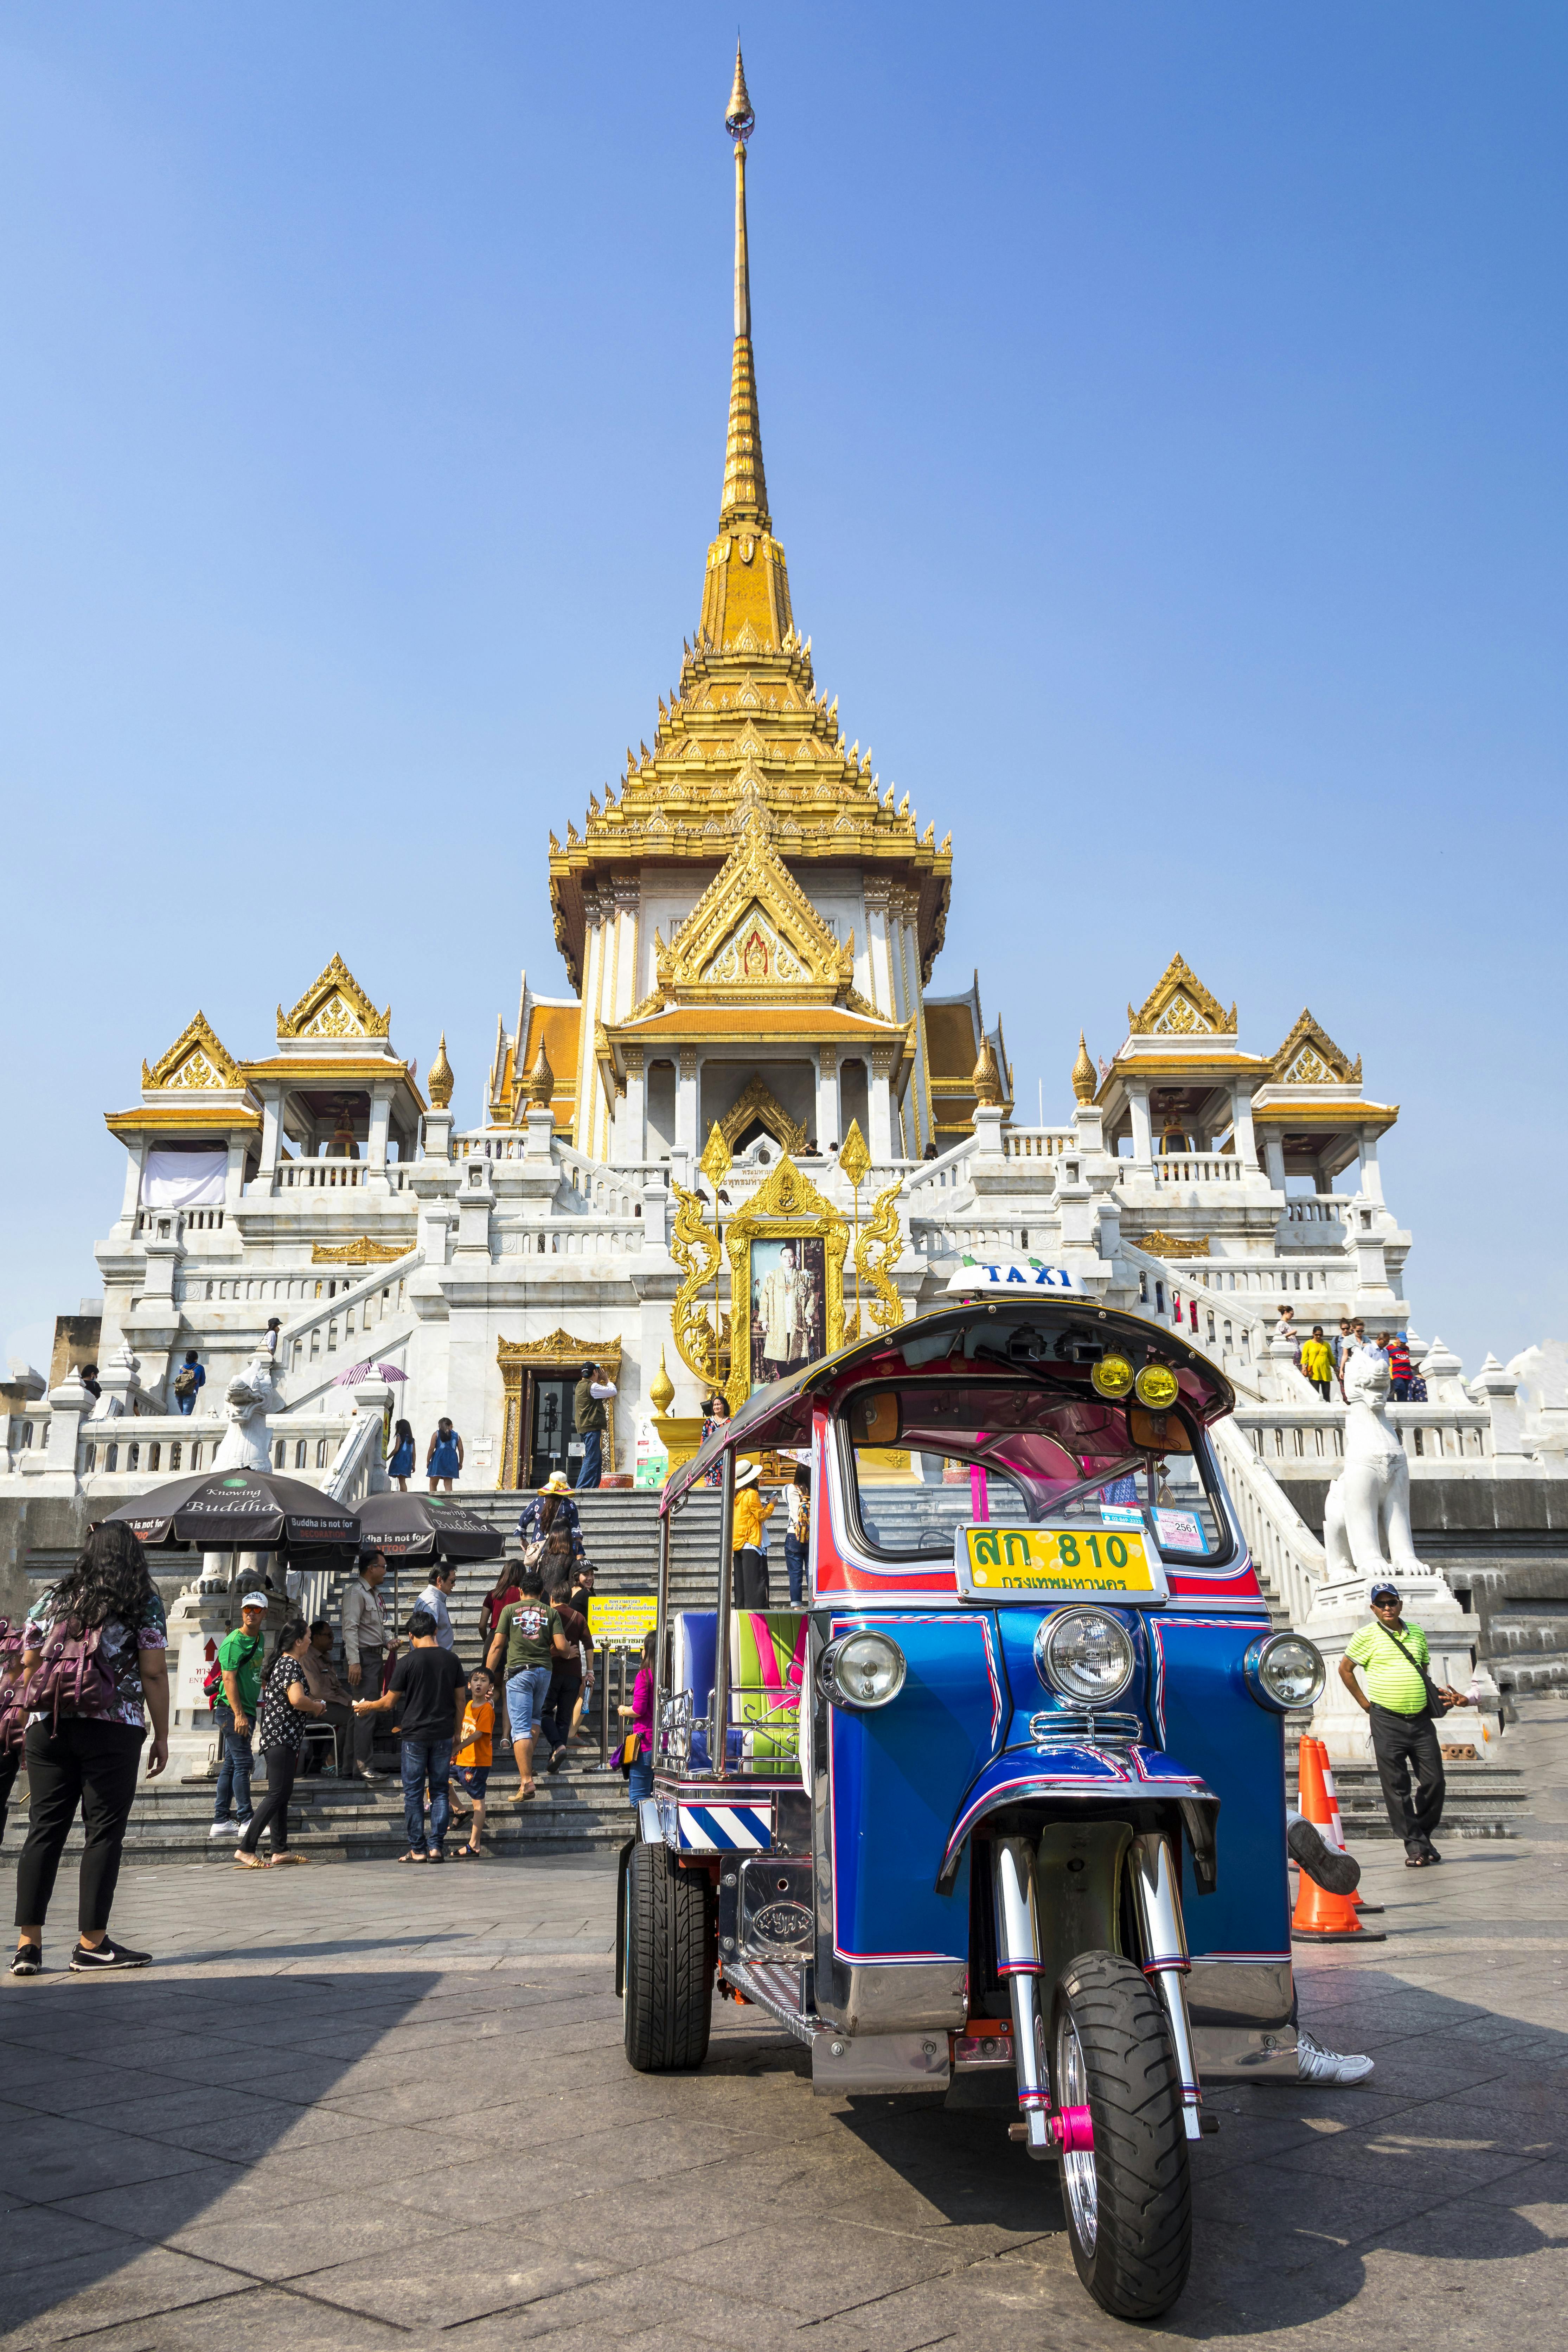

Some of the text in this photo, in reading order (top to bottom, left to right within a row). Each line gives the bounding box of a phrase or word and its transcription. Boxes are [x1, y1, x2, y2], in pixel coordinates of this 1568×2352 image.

[982, 1265, 1071, 1287] TAXI
[206, 1489, 261, 1497] Knowing
[186, 1500, 275, 1512] Buddha
[428, 1507, 466, 1519] Knowing
[134, 1520, 141, 1529] is
[142, 1520, 154, 1529] not
[155, 1519, 165, 1528] for
[291, 1517, 353, 1528] Buddha is not for
[433, 1519, 491, 1532] Buddha
[1175, 1523, 1197, 1533] 2561
[300, 1530, 346, 1538] DECORATION
[384, 1534, 392, 1542] is
[395, 1534, 410, 1542] not
[412, 1533, 425, 1541] for
[973, 1530, 1128, 1568] สก 810
